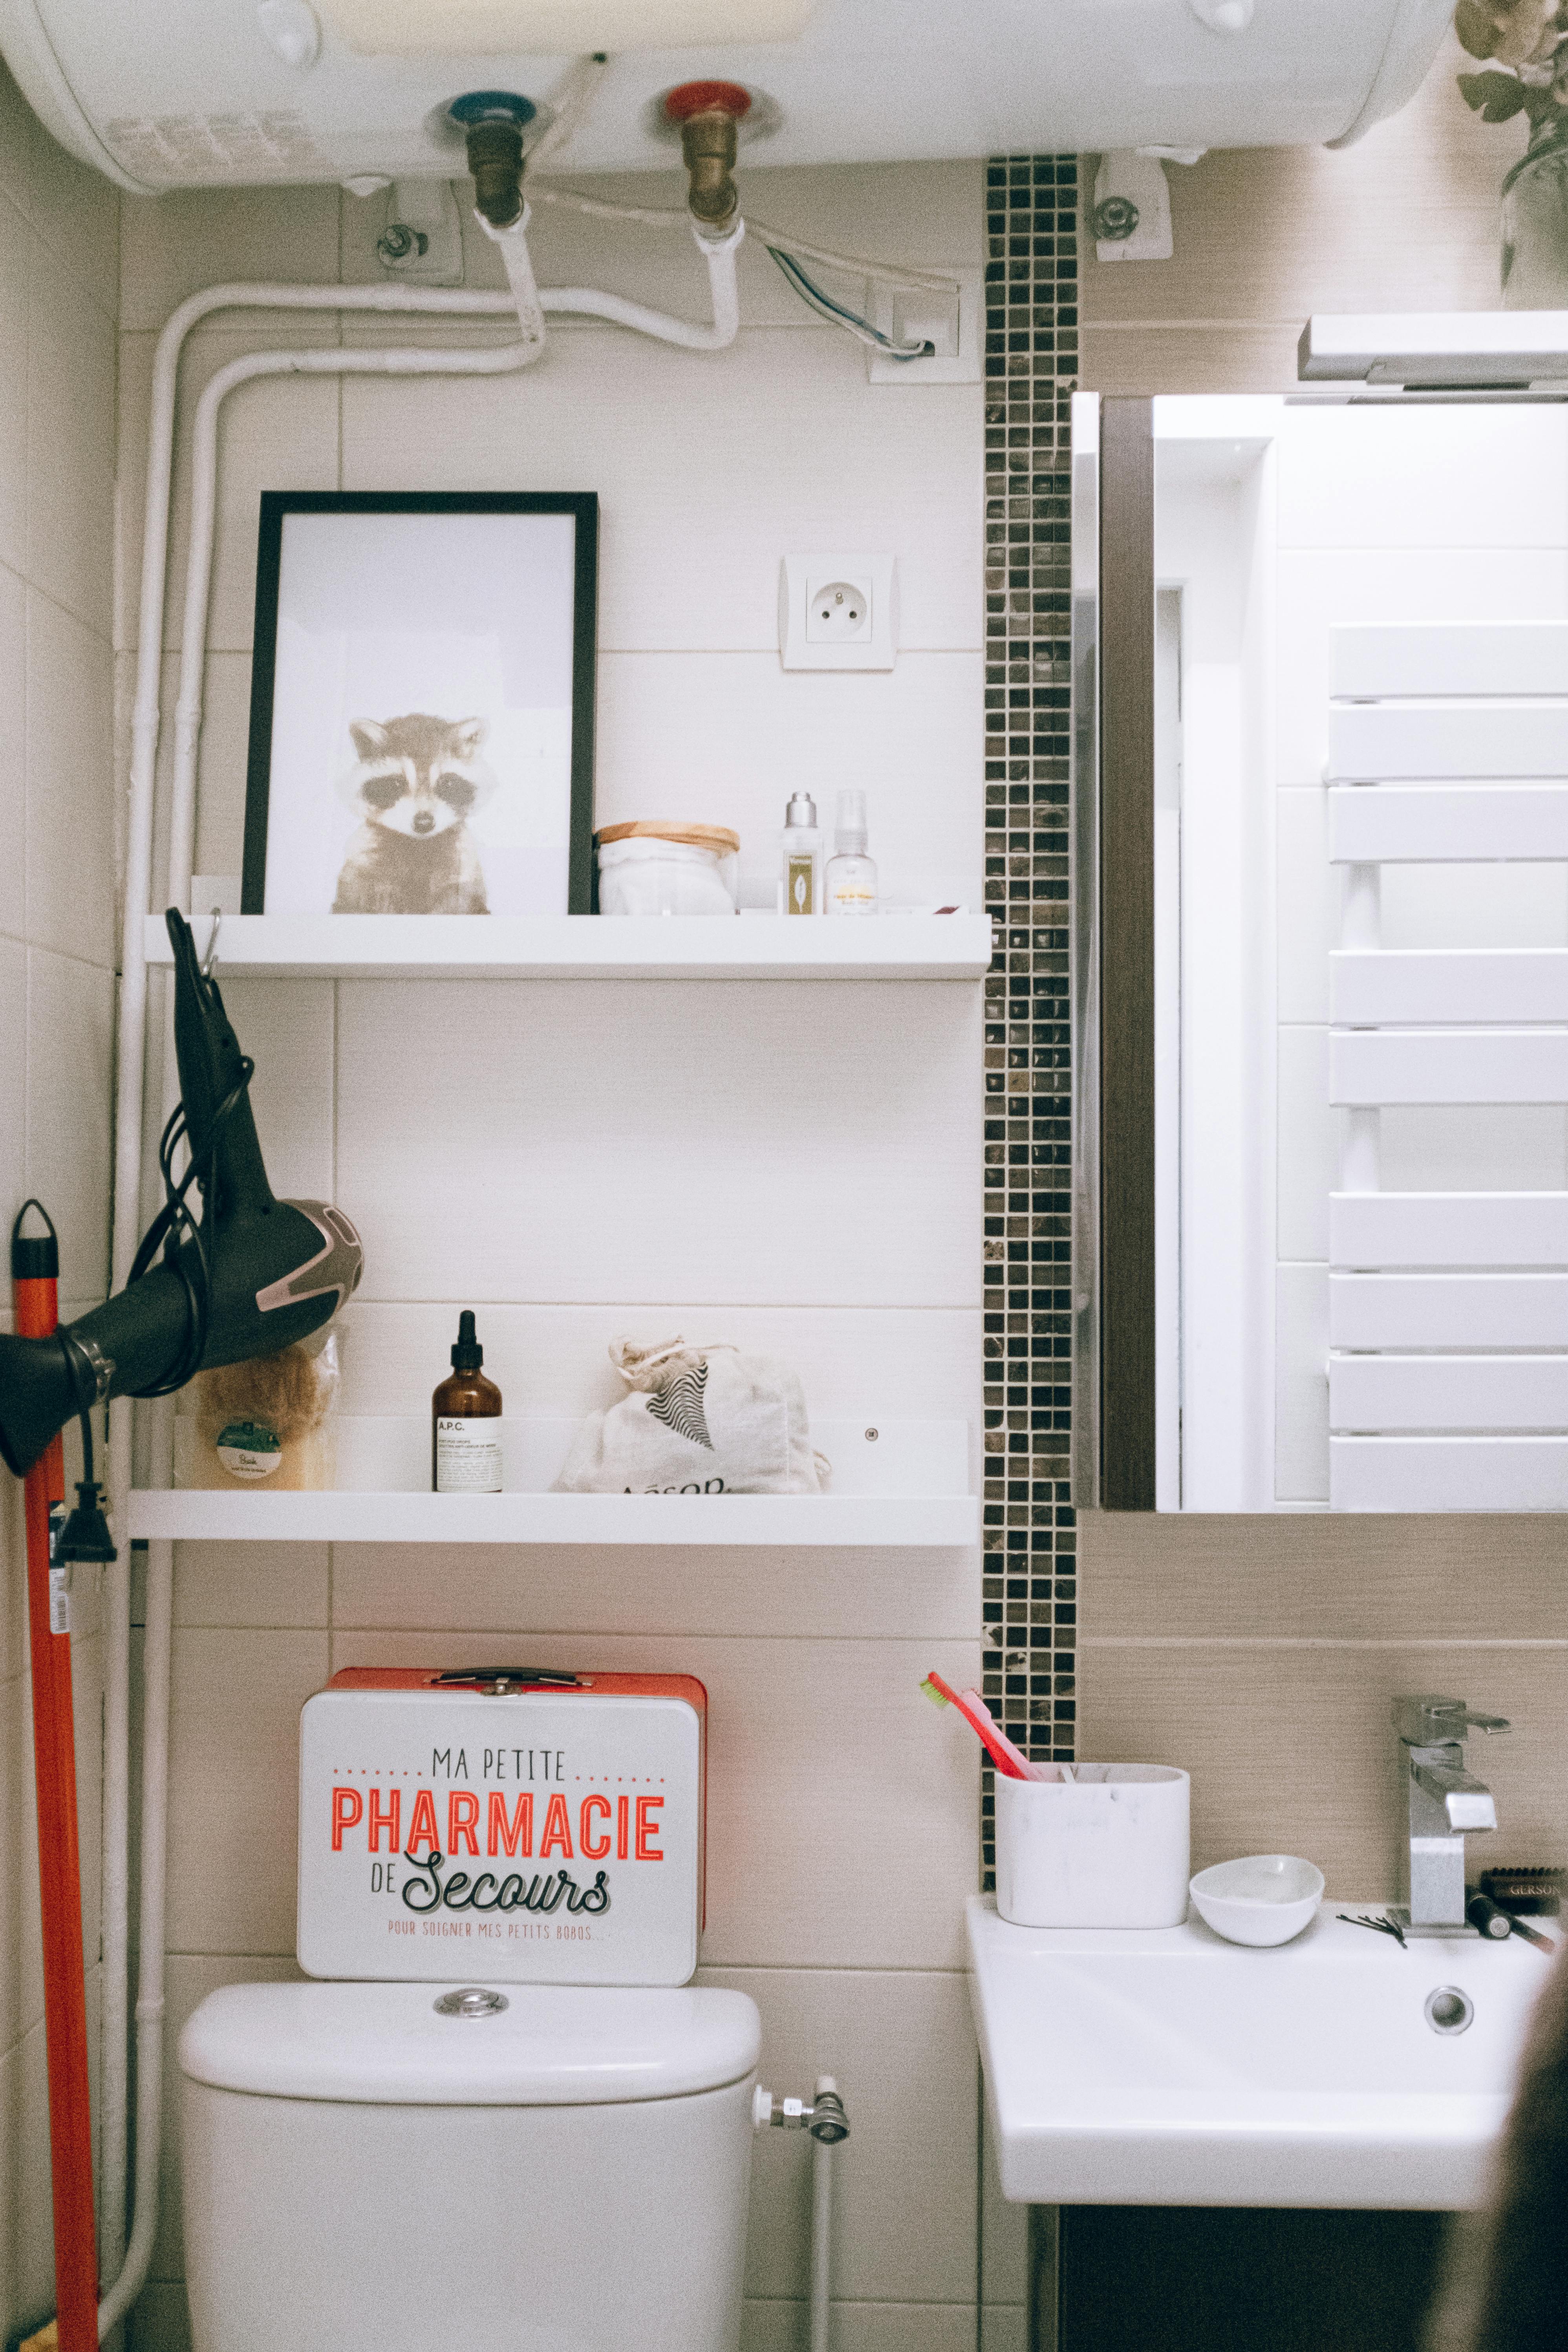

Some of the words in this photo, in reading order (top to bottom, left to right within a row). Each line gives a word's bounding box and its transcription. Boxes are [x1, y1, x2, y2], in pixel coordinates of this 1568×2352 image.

[439, 1421, 465, 1431] A.P.C.
[432, 1748, 468, 1779] MA
[484, 1748, 565, 1781] PETITE
[331, 1787, 664, 1861] PHARMACIE
[371, 1863, 395, 1893] DE
[401, 1850, 611, 1916] Secours
[1510, 1884, 1561, 1895] GERSON
[388, 1920, 415, 1935] POUR
[423, 1922, 471, 1937] SOIGNER
[478, 1923, 501, 1938] MES
[508, 1924, 550, 1939] PETITS
